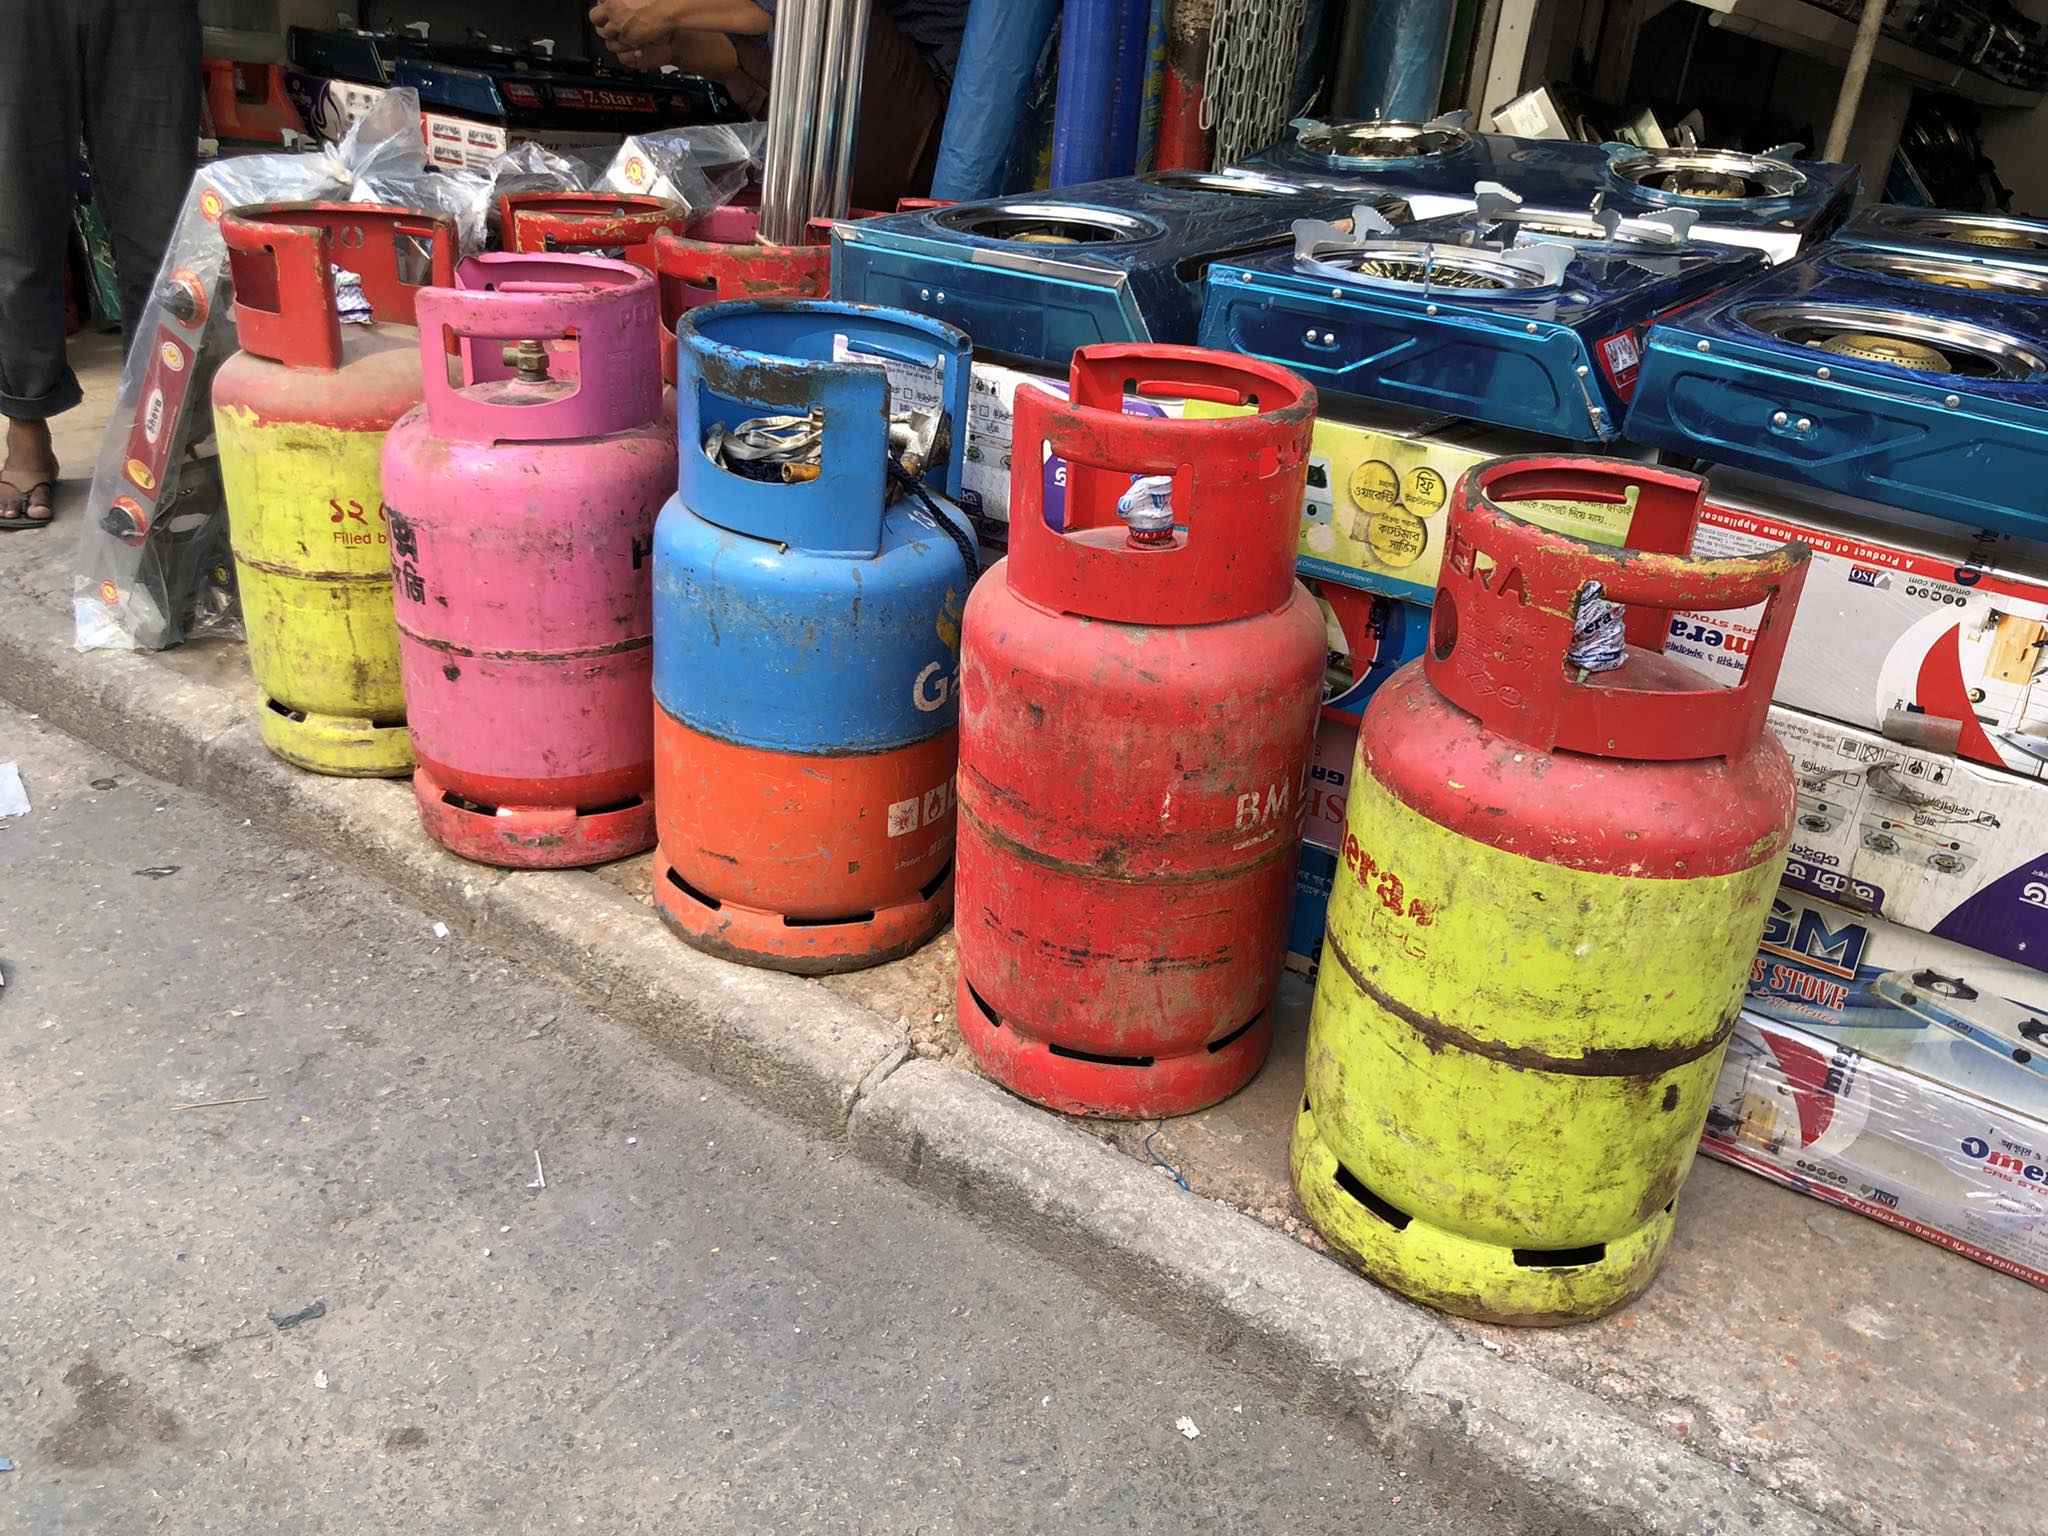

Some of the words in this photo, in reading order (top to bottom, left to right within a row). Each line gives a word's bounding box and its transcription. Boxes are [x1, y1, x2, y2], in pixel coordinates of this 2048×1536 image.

[601, 91, 634, 106] Star
[330, 499, 368, 526] ১২
[333, 532, 372, 545] Filled
[1763, 526, 1792, 541] Home
[1797, 534, 1832, 550] Omera
[1837, 544, 1848, 553] of
[1854, 548, 1899, 565] Product
[1322, 564, 1340, 576] Home
[1341, 569, 1373, 584] Appliances
[1852, 569, 1875, 583] ISO
[1908, 577, 1971, 597] omeraha.com
[1670, 619, 1755, 656] mera
[1789, 843, 1840, 868] স্টেইন
[1760, 897, 1869, 973] GM
[1769, 962, 1850, 1012] STOVE
[1874, 1190, 1897, 1207] ISO
[1853, 1201, 1896, 1222] Product
[1899, 1218, 1911, 1229] of
[1915, 1225, 1947, 1244] Omera
[1952, 1241, 1981, 1258] Home
[1985, 1254, 2046, 1284] Appliances
